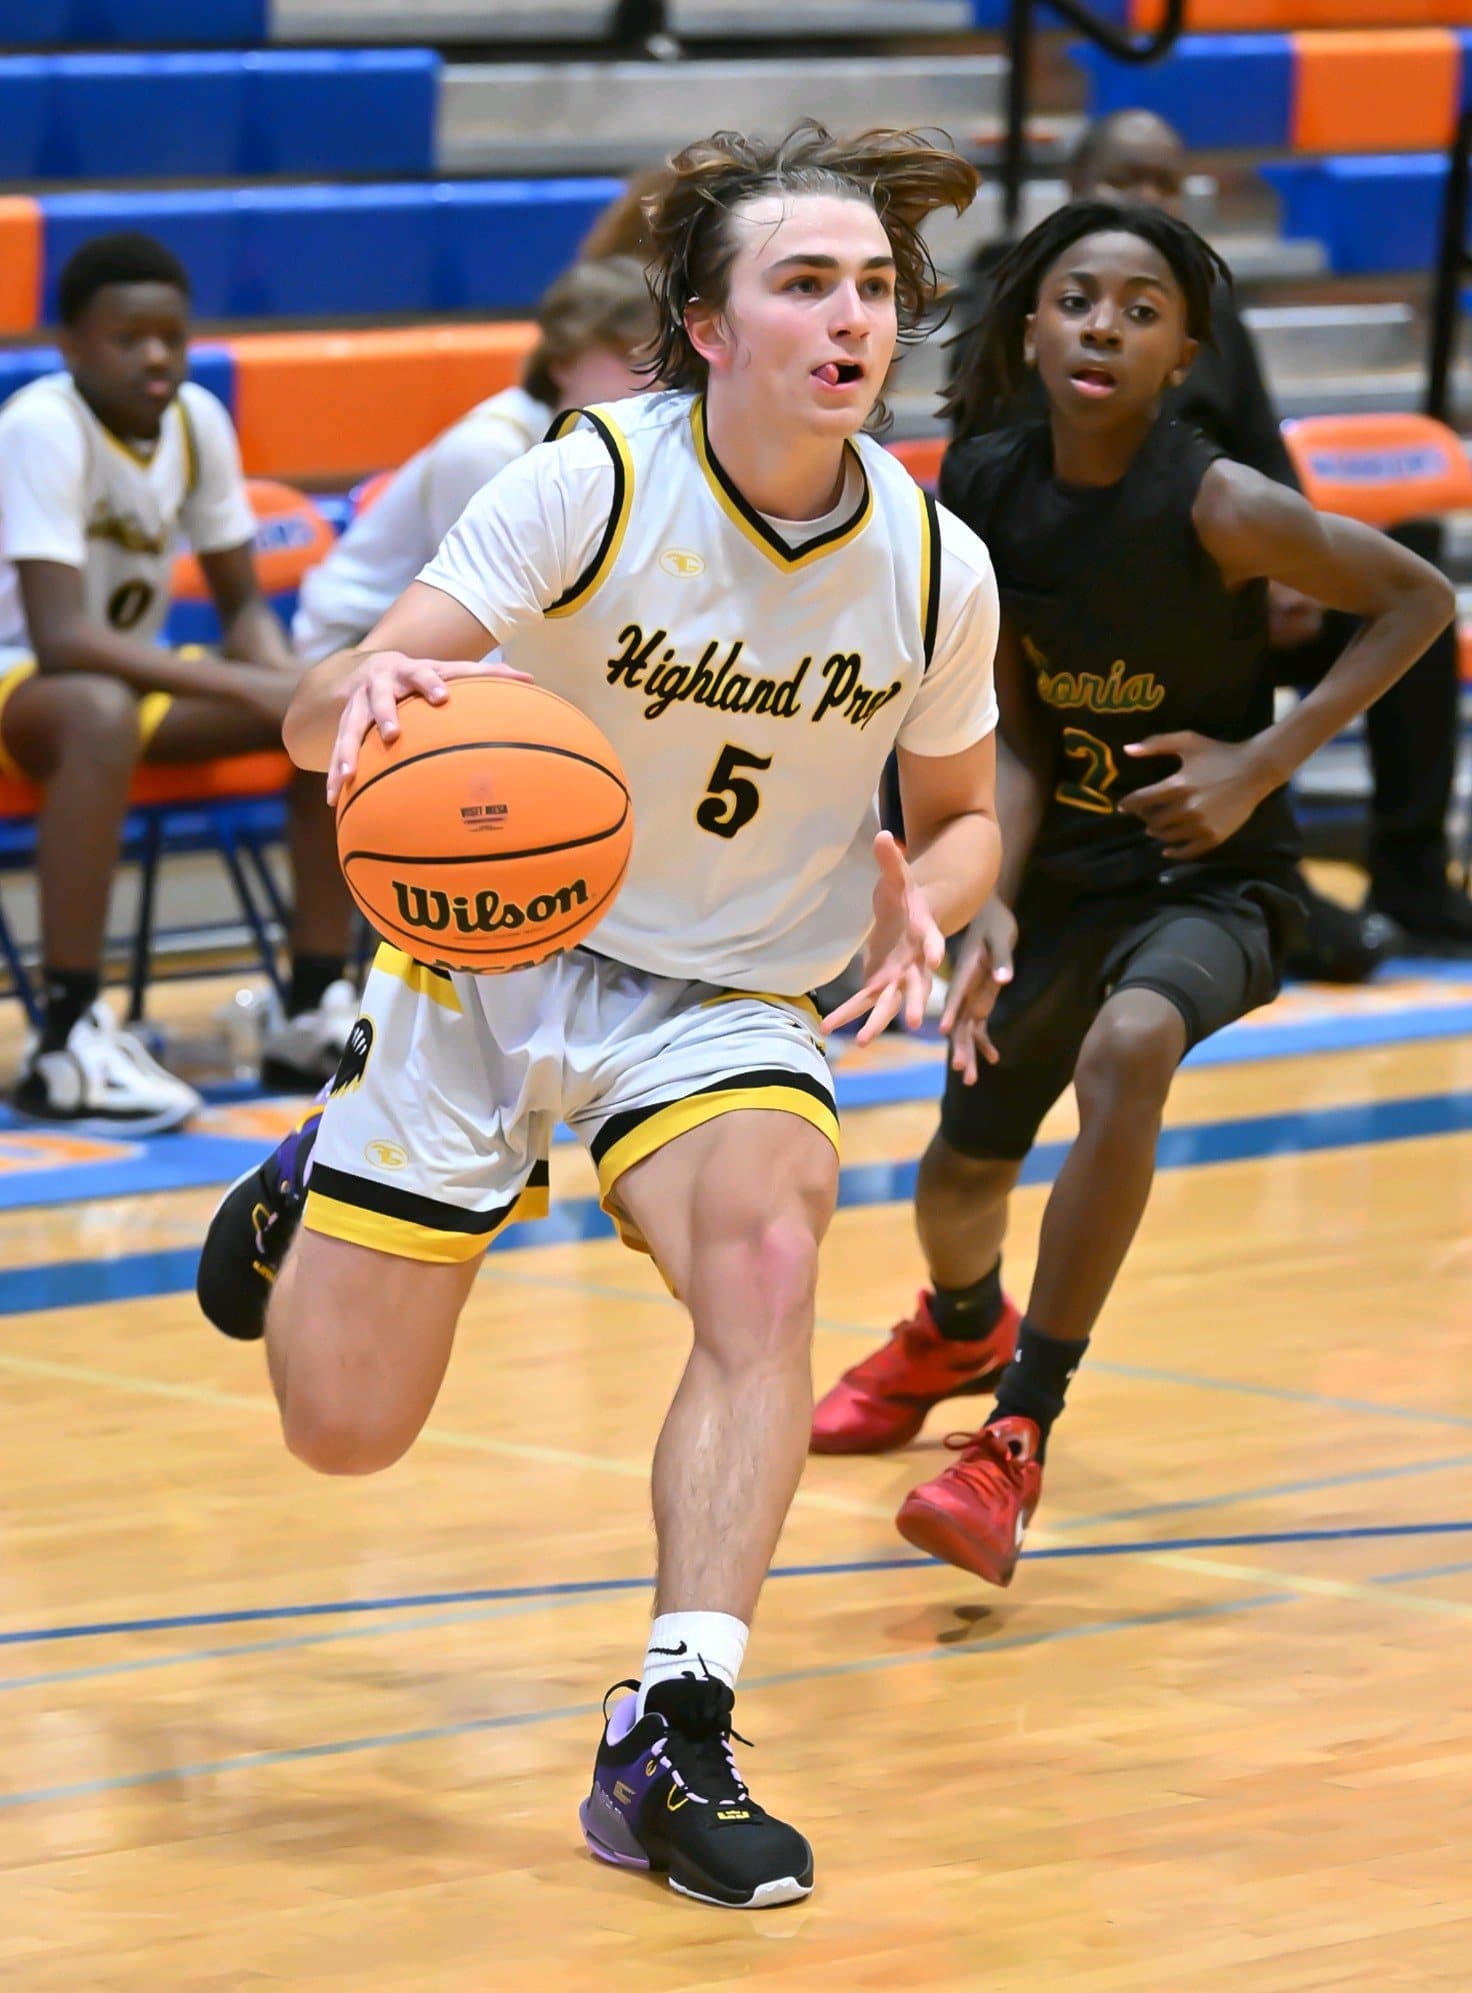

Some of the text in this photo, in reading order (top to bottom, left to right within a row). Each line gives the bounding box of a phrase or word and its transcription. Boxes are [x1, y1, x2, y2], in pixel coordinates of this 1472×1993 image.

[606, 624, 813, 721] Highland
[696, 743, 774, 839] 5
[1055, 726, 1120, 814] 2
[391, 878, 590, 934] Wilson
